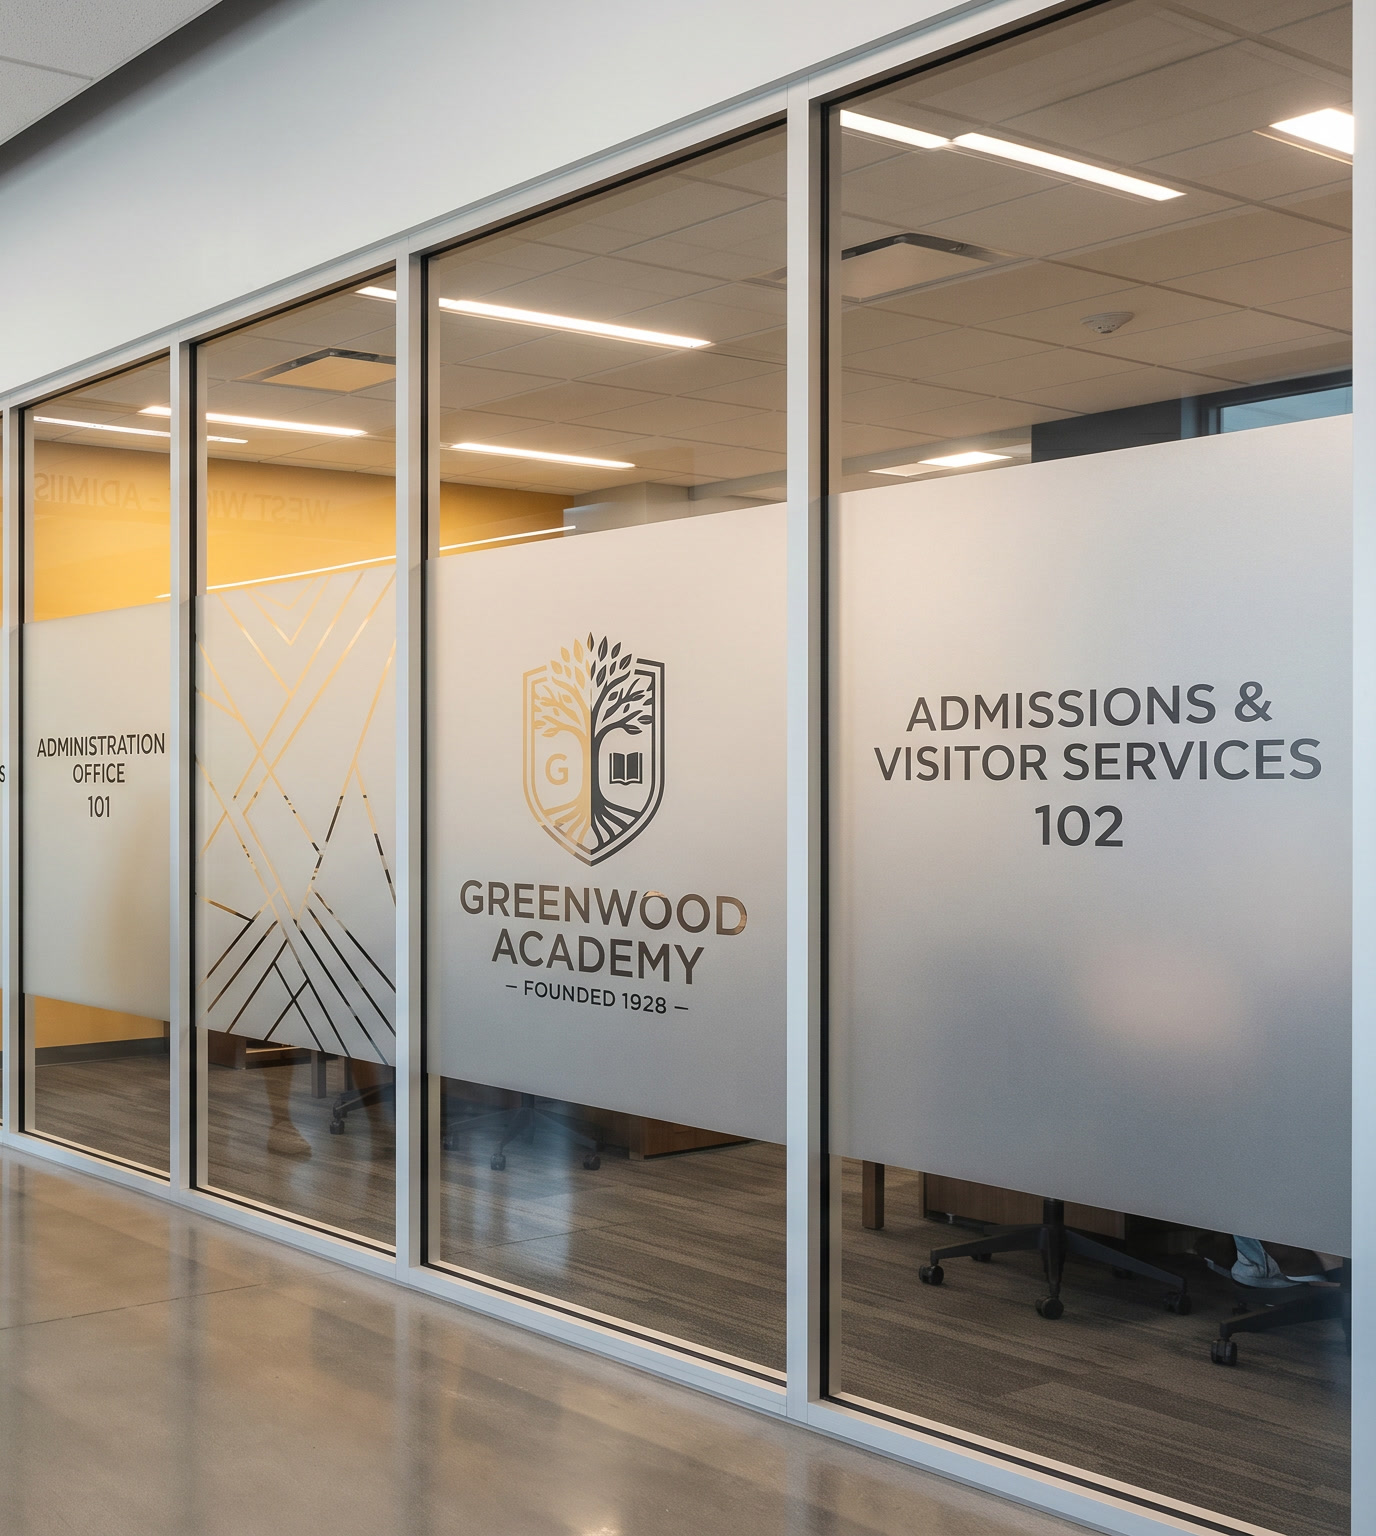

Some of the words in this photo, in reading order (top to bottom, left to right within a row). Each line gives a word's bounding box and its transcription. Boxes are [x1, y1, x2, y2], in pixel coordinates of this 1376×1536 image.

[905, 683, 1217, 732] ADMISSIONS
[1234, 680, 1273, 722] &
[36, 732, 165, 757] ADMINISTRATION
[873, 744, 1048, 781] VISITOR
[1062, 738, 1323, 780] SERVICES
[72, 763, 126, 783] OFFICE
[544, 752, 569, 786] G
[87, 795, 110, 817] 101
[1034, 804, 1124, 848] 102
[459, 879, 748, 936] GREENWOOD
[491, 928, 705, 985] ACADEMY
[524, 980, 616, 1007] FOUNDED
[621, 992, 667, 1014] 1928
